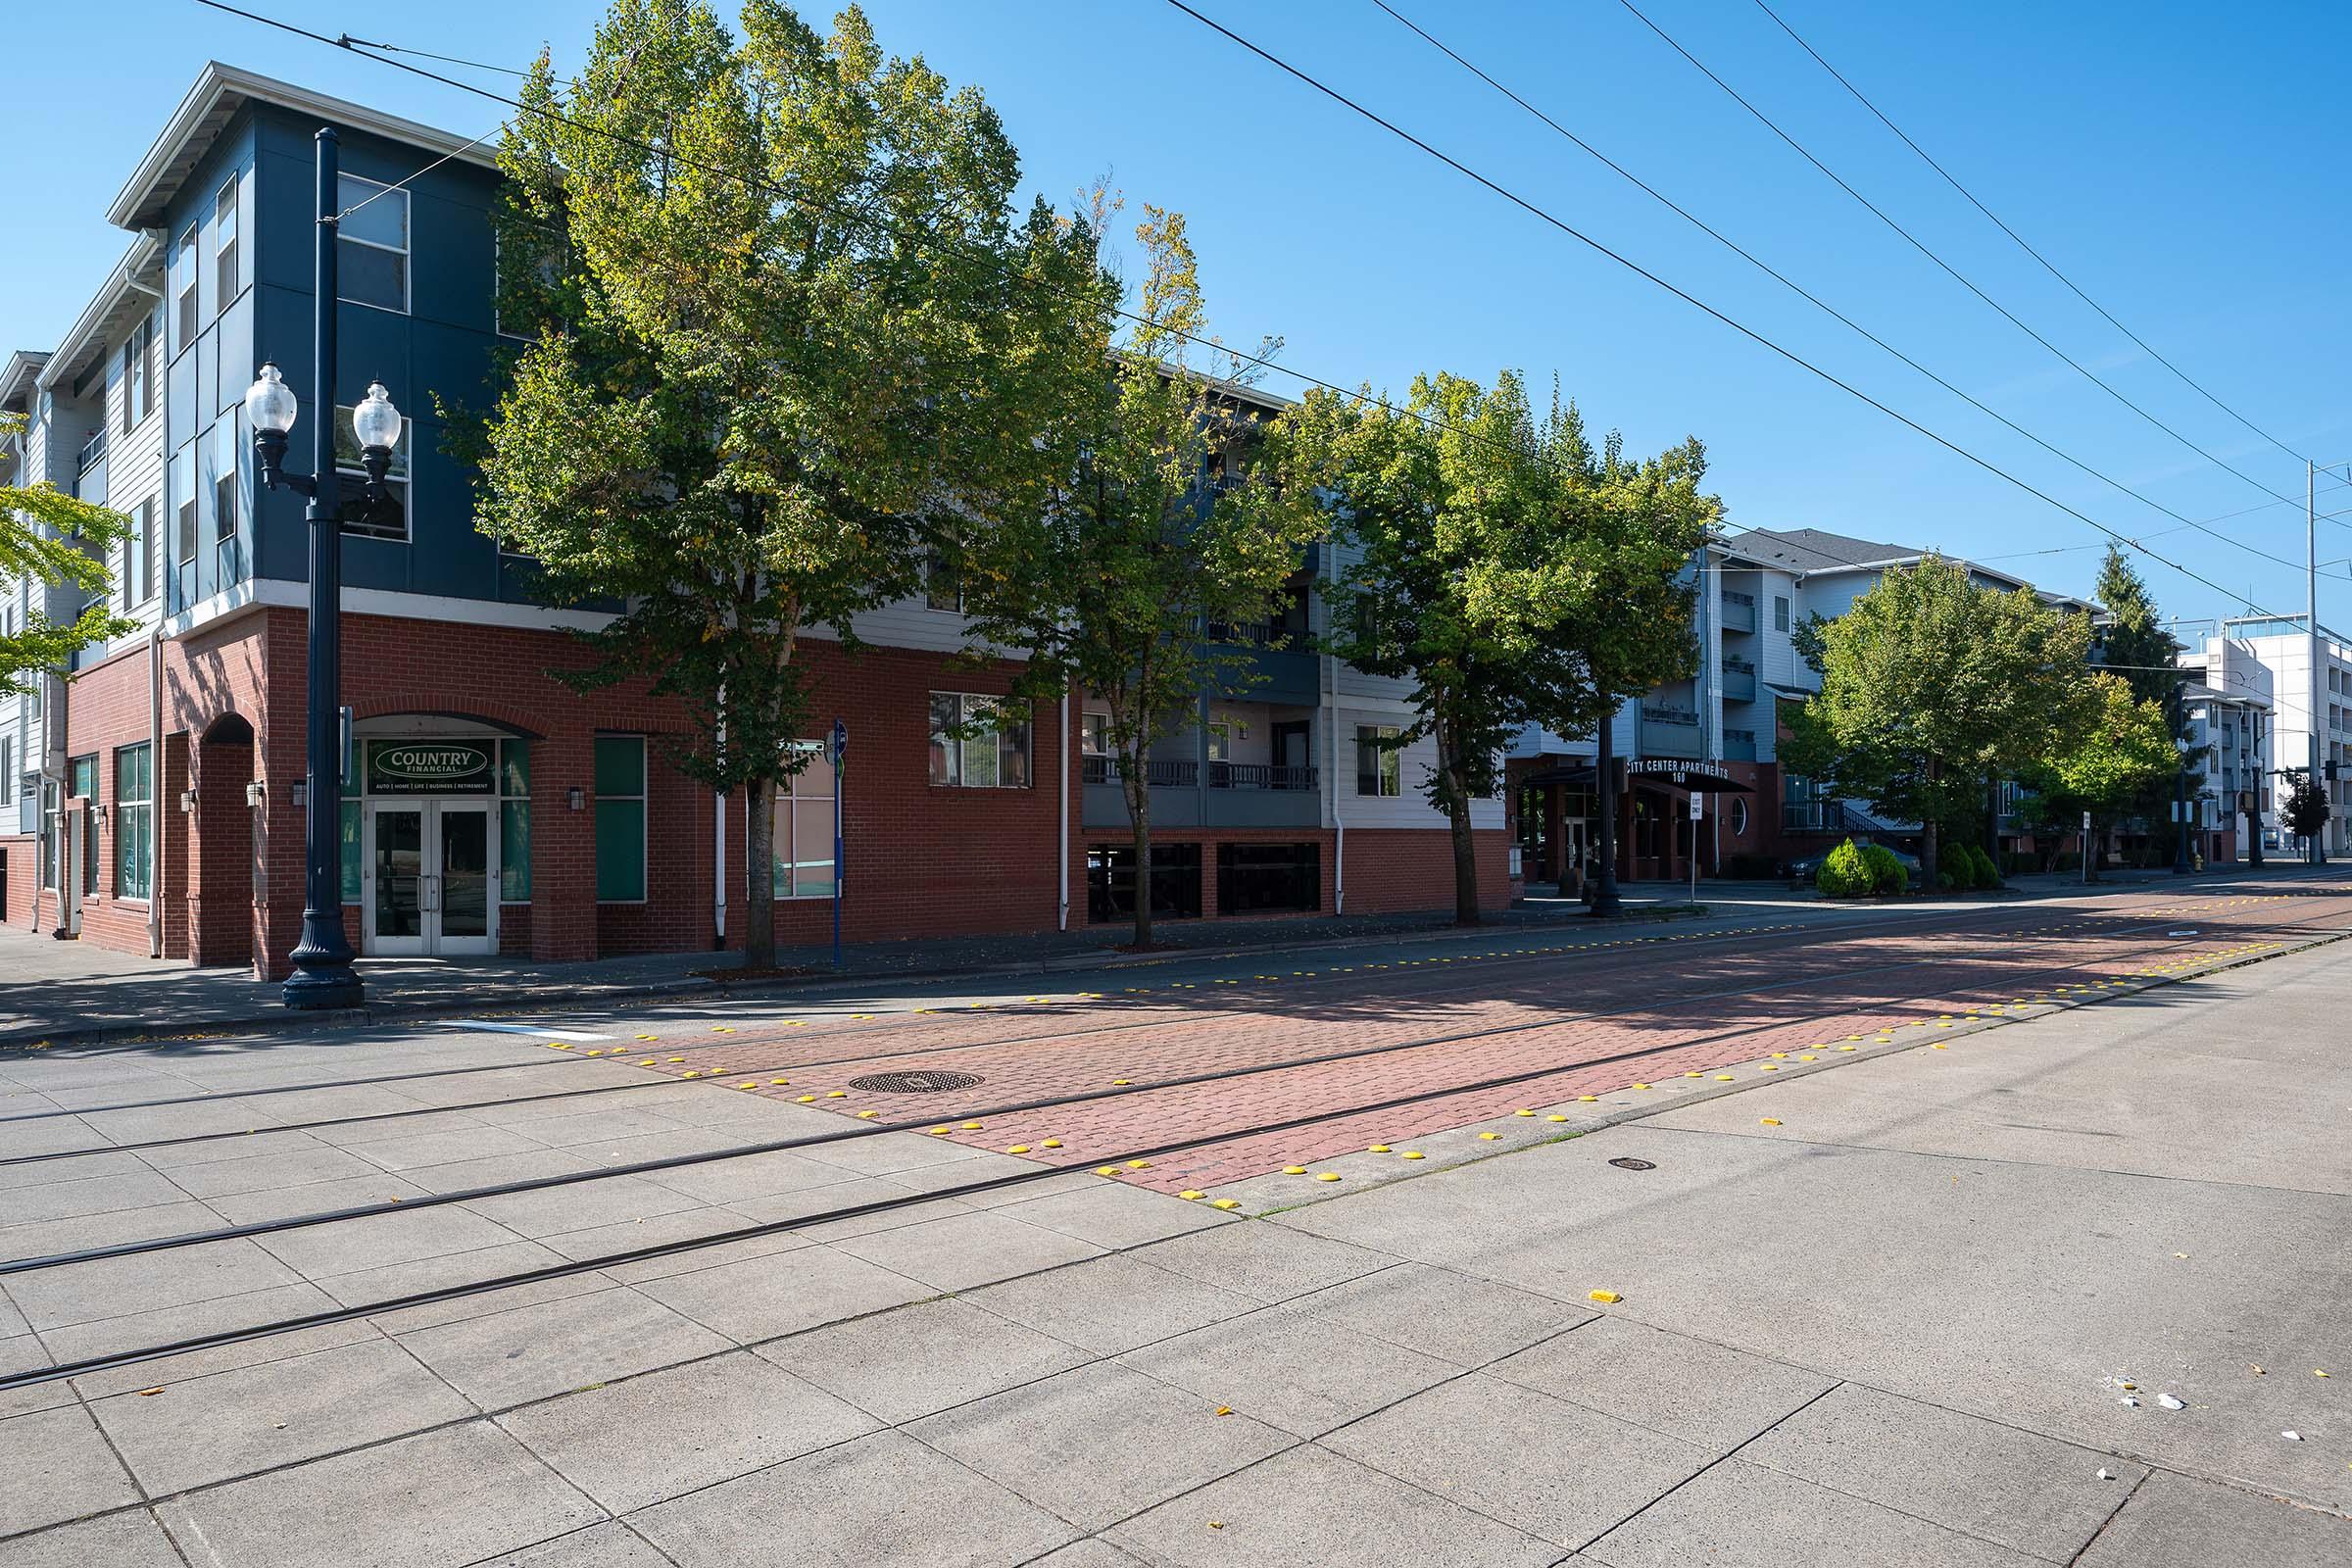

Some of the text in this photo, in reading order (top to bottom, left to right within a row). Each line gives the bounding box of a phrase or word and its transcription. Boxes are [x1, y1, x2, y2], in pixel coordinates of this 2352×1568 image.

[392, 752, 470, 765] COUNTRY
[1646, 760, 1678, 772] CENTER
[1680, 760, 1729, 779] APARTMENTS
